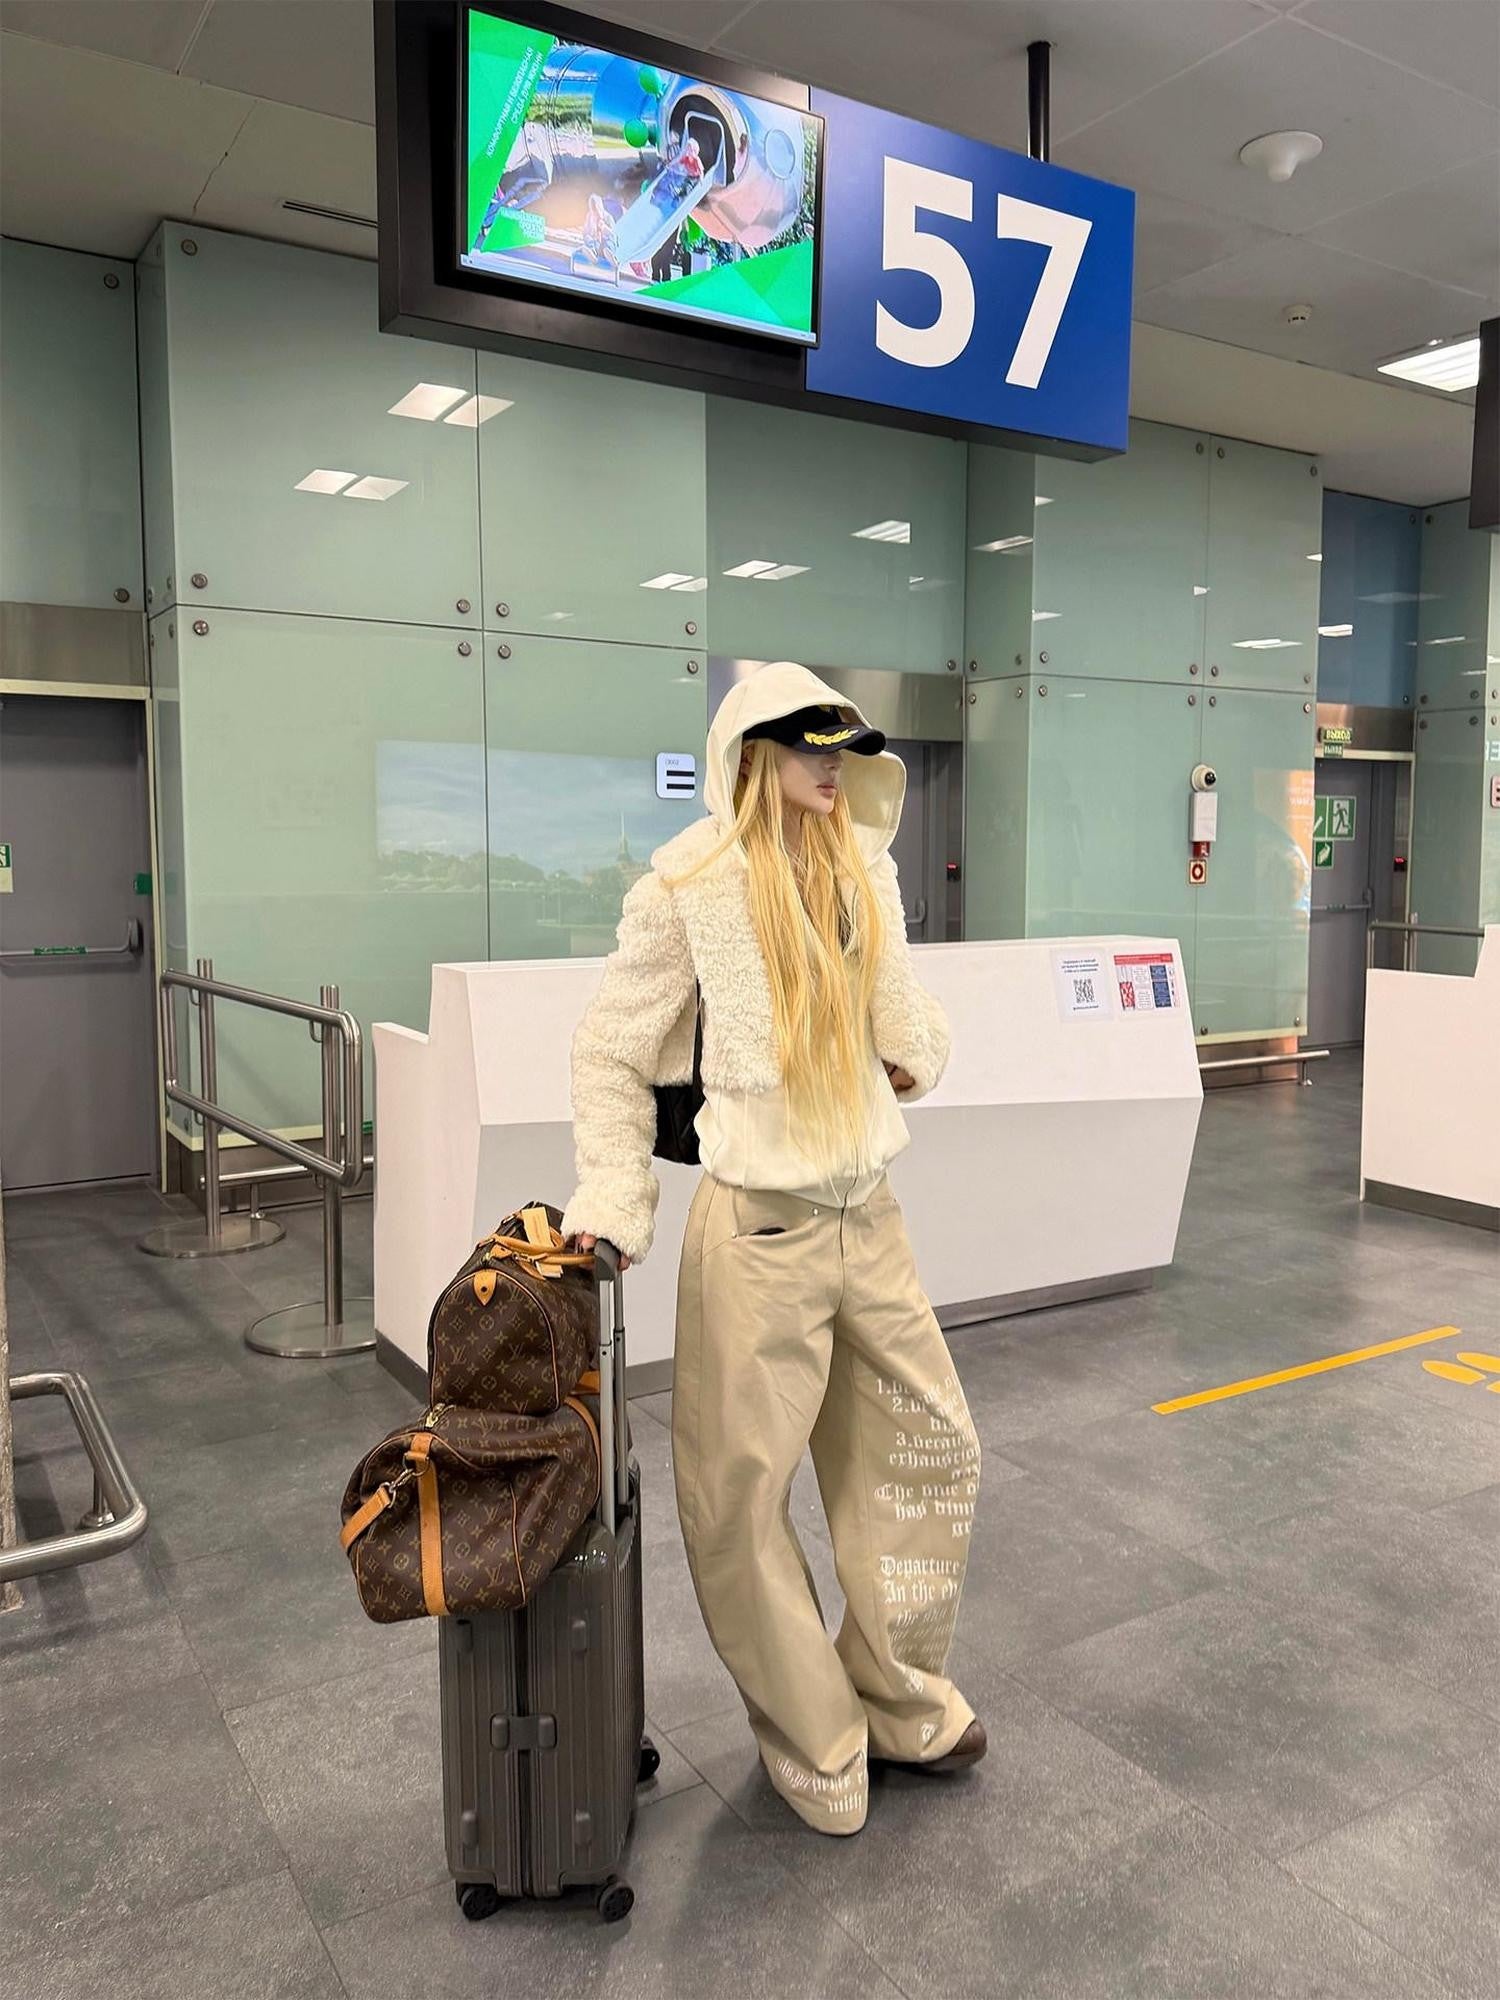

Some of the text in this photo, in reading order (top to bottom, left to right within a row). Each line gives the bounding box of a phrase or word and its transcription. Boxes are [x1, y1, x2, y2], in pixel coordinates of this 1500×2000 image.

[875, 154, 1093, 390] 57
[879, 1554, 960, 1580] Departure
[911, 1578, 936, 1605] the
